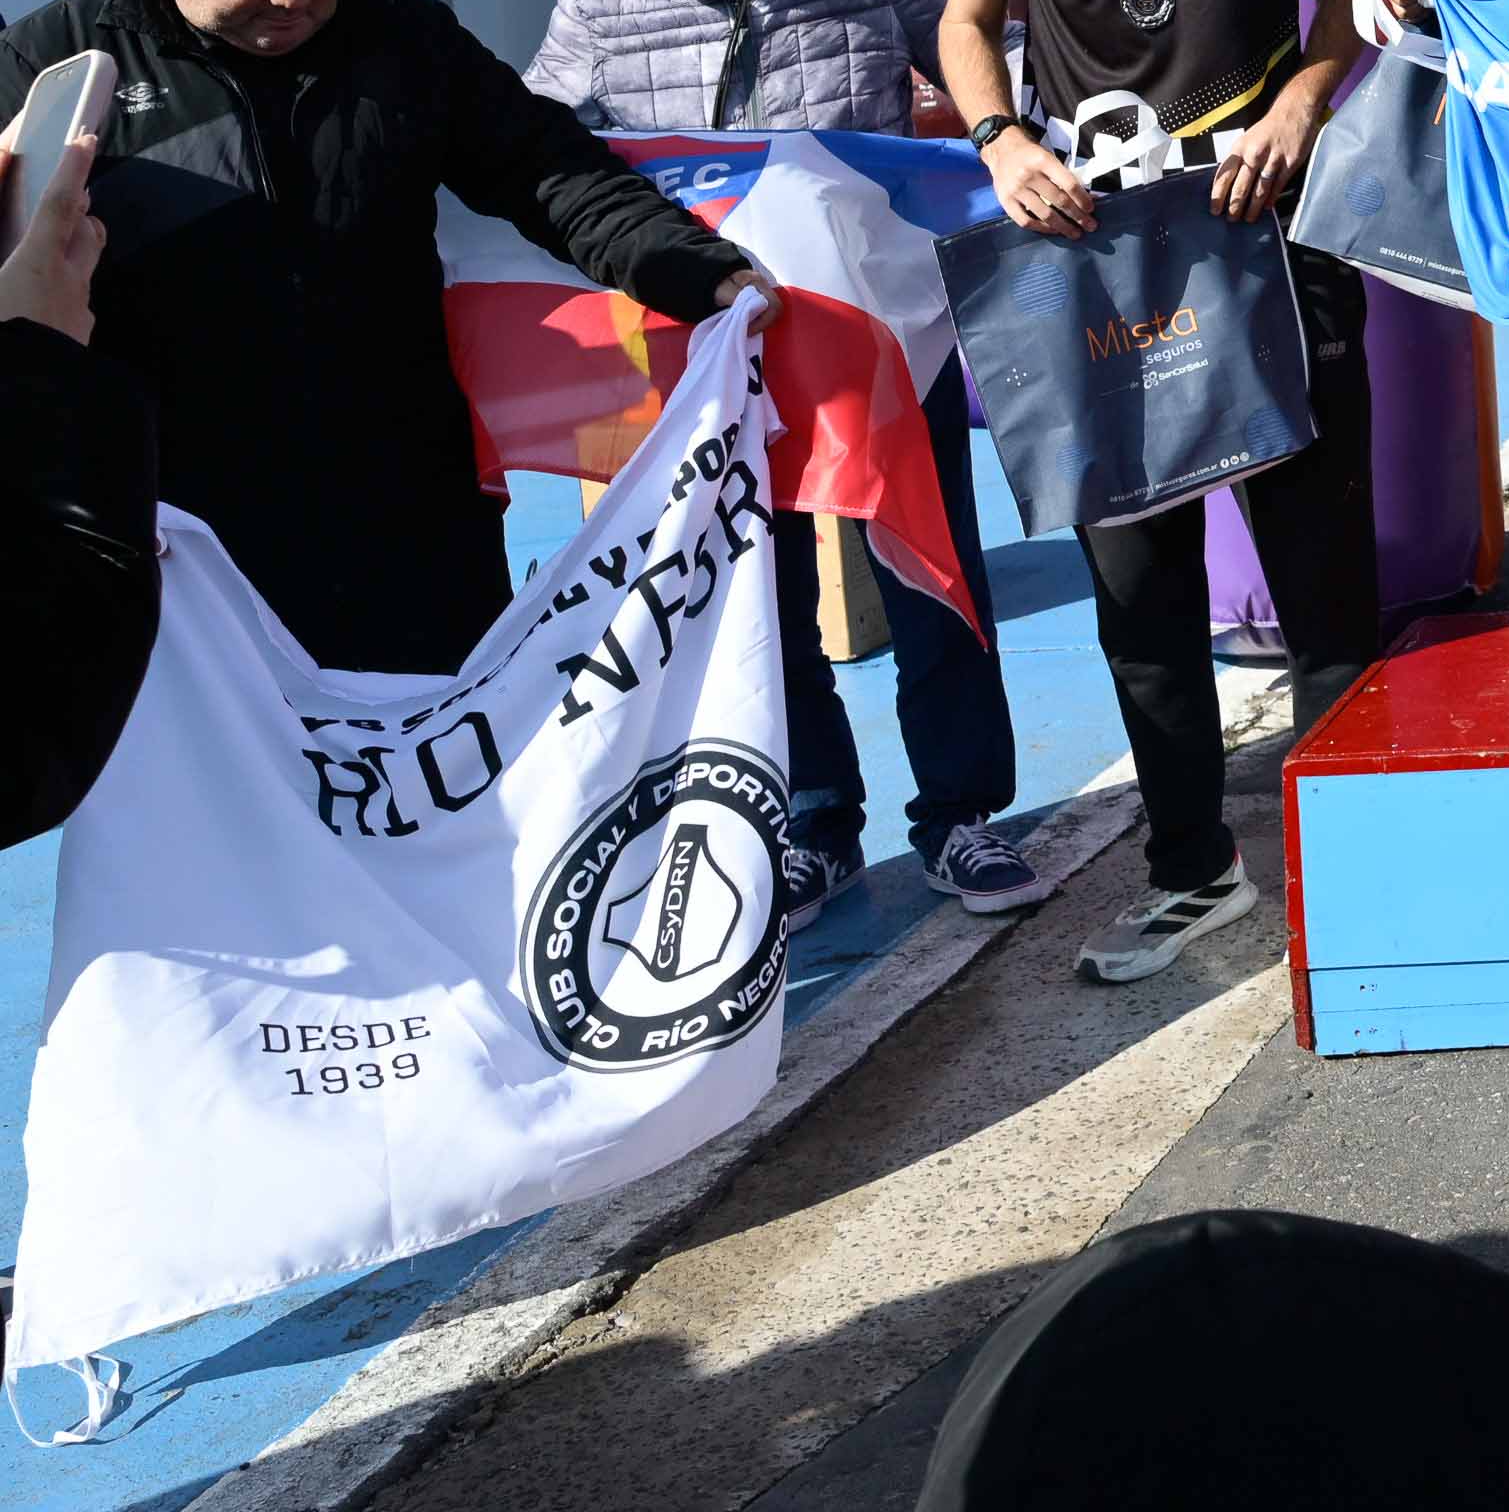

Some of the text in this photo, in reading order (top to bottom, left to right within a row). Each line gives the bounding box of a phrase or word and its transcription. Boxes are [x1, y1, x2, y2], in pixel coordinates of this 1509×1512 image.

[1086, 306, 1199, 362] Mista
[546, 762, 790, 1049] CLUB SOCIAL Y DEPORTIVO
[717, 912, 789, 1022] NEGRO
[259, 1016, 431, 1054] DESDE
[285, 1052, 421, 1096] 1939
